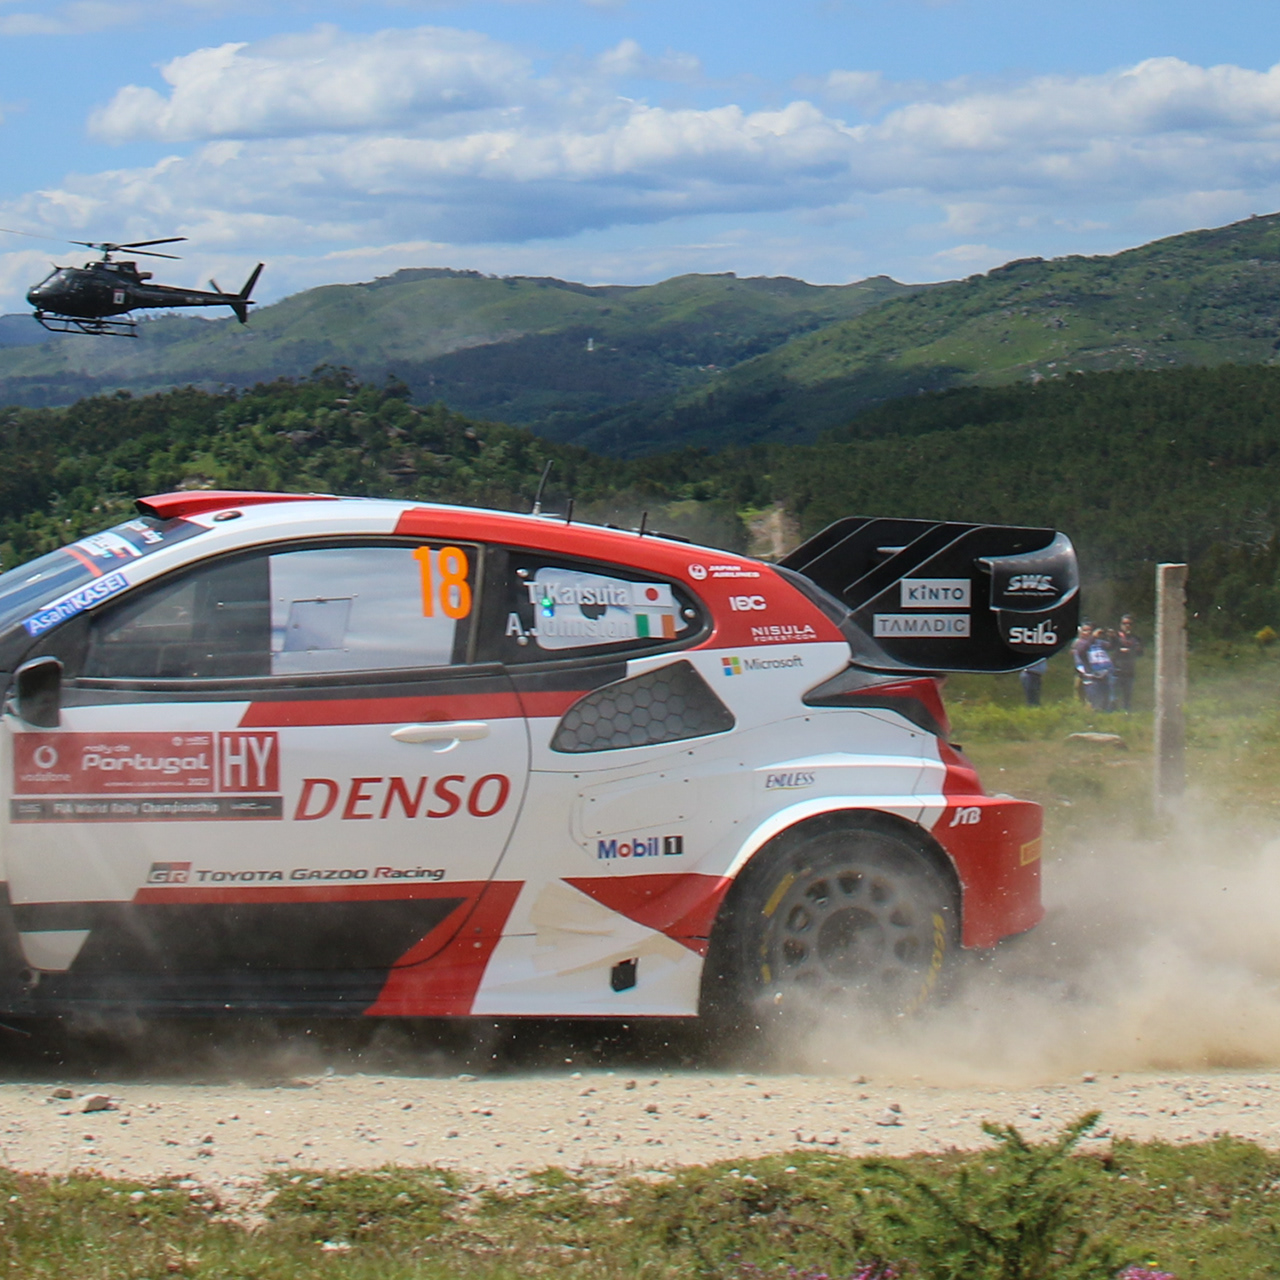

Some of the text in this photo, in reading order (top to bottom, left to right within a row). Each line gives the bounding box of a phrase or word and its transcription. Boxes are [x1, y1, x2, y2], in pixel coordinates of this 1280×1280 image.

[412, 546, 472, 618] 18
[751, 625, 815, 636] NISULA
[879, 619, 965, 632] TAMADIC
[1009, 620, 1057, 645] Stilo
[744, 655, 803, 671] Microsoft
[82, 744, 130, 754] rally de
[82, 753, 210, 774] Portugal
[222, 736, 273, 787] HY
[766, 772, 815, 788] ENDLESS
[294, 774, 511, 821] DENSO
[141, 801, 219, 813] Championship
[597, 837, 659, 859] Mobil
[147, 866, 446, 883] GR TOYOTA GAZOO Racing
